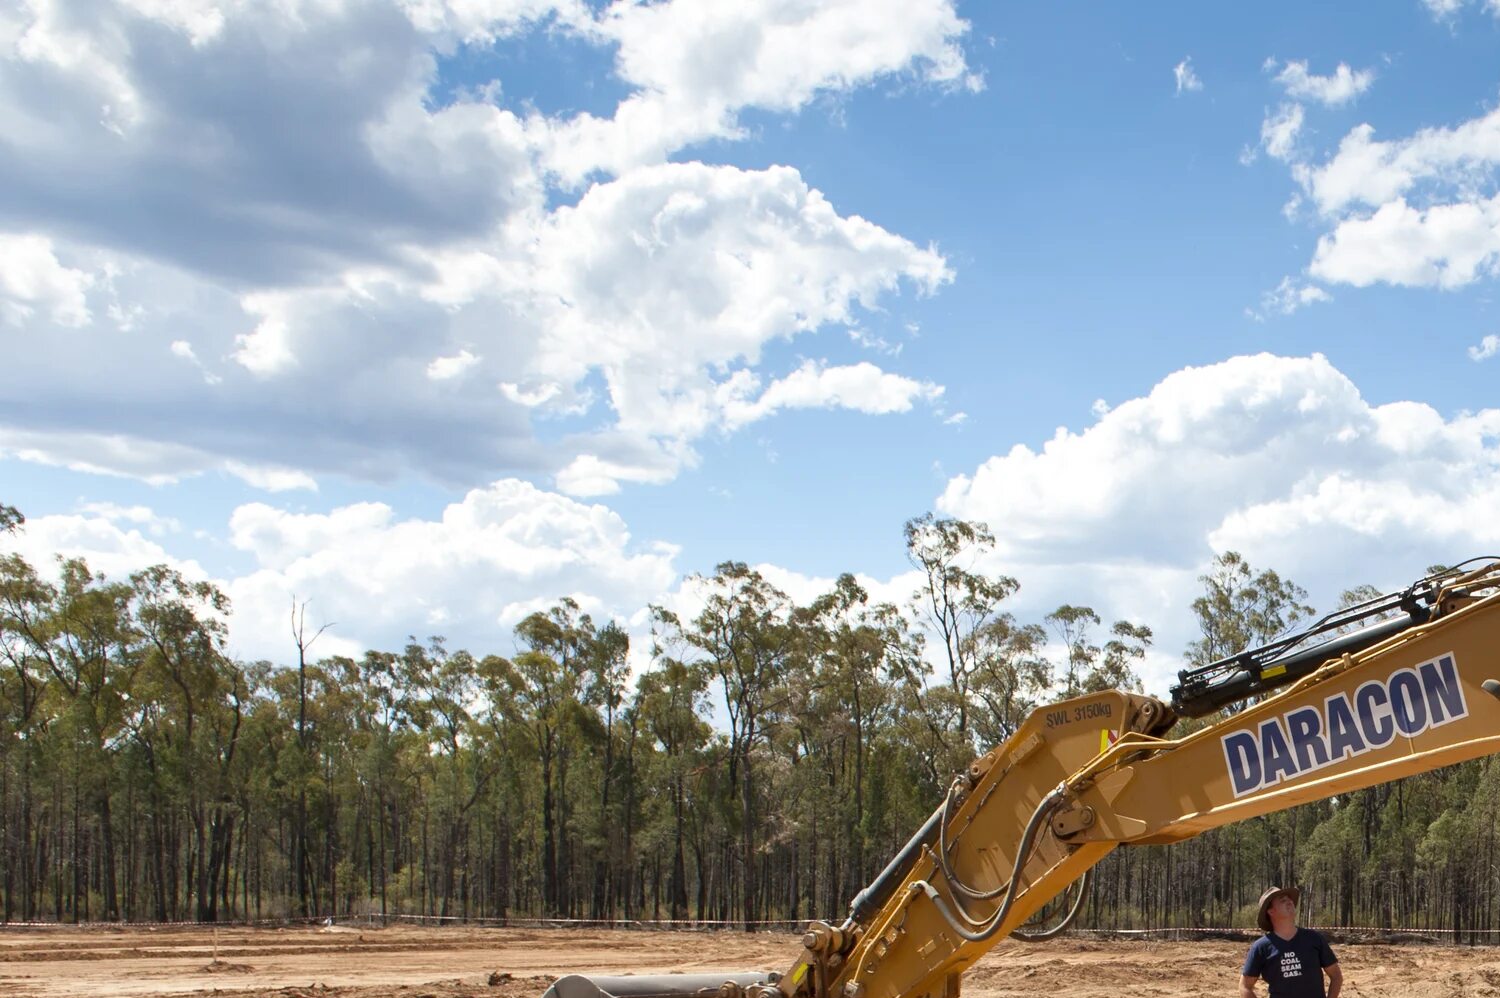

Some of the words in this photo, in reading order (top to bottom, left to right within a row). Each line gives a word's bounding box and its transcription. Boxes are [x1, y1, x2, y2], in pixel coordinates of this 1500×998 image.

[1046, 709, 1071, 728] SWL
[1074, 702, 1112, 722] 3150kg
[1221, 651, 1469, 799] DARACON
[1281, 957, 1300, 965] COAL
[1281, 964, 1301, 972] SEAM
